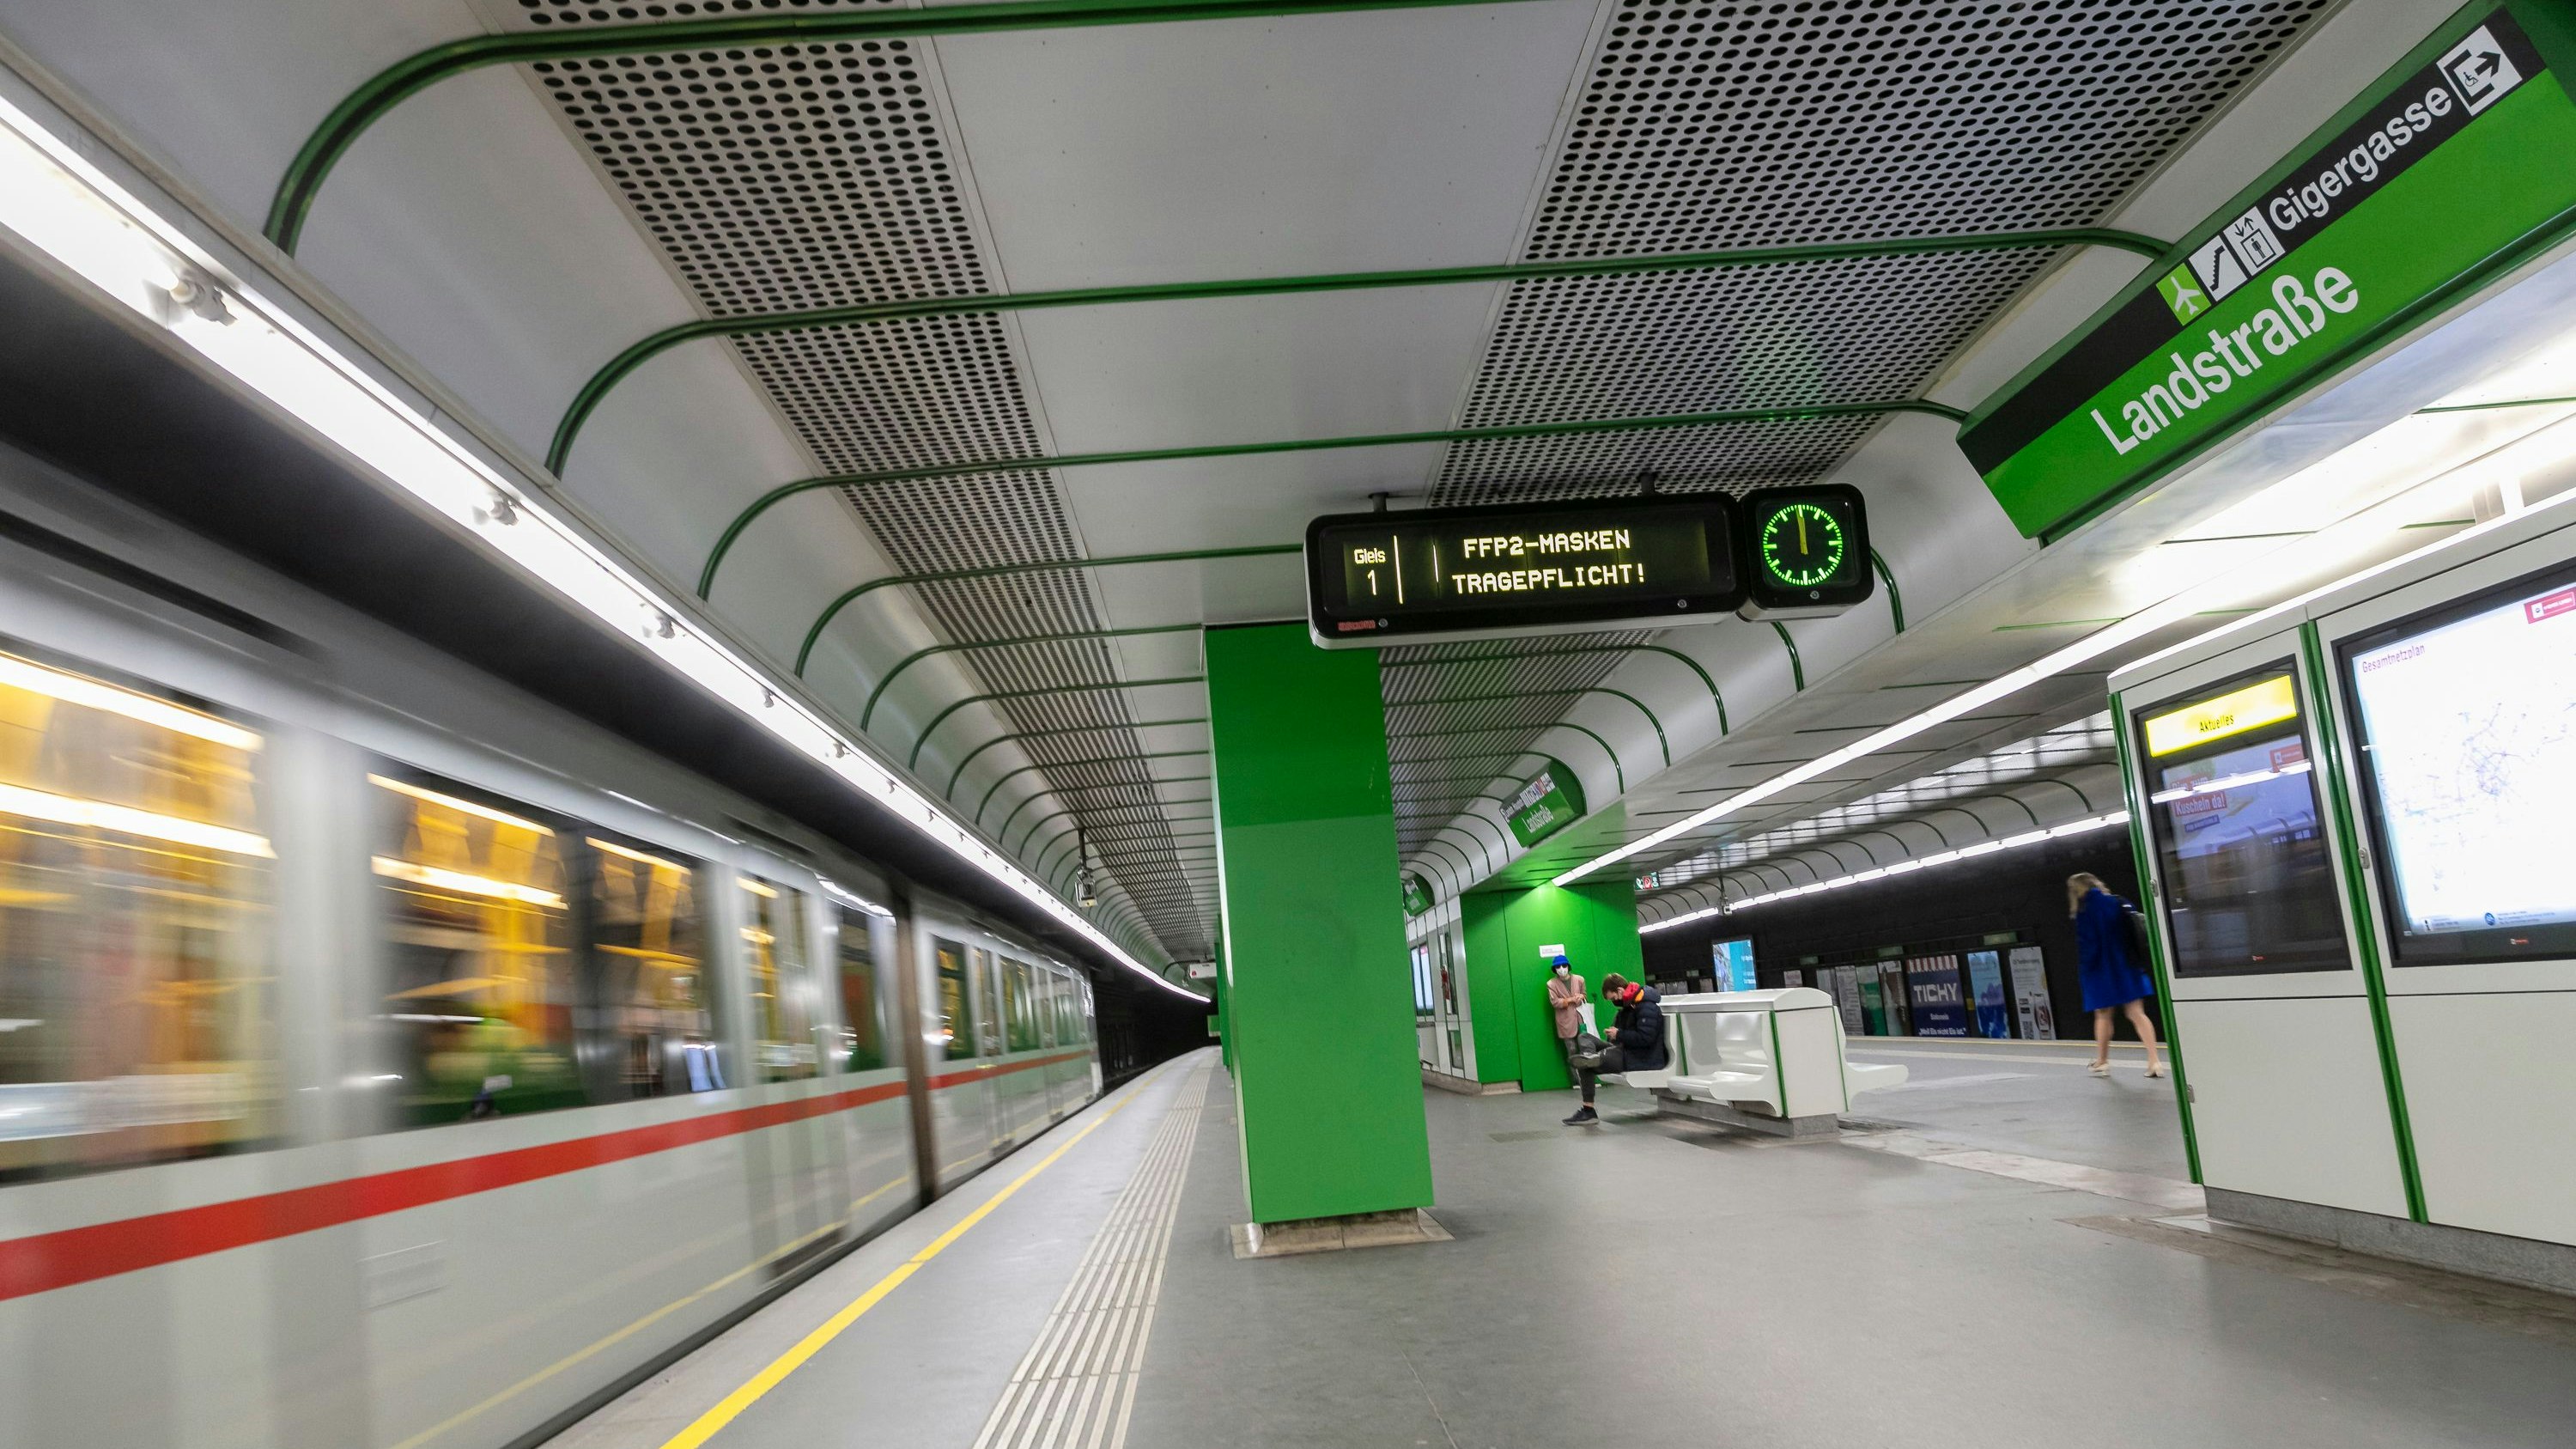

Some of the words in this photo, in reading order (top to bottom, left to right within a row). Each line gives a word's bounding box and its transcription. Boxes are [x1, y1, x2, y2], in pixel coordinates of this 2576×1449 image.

[2269, 86, 2452, 231] Gigergasse
[2090, 266, 2360, 456] Landstraße
[1353, 547, 1387, 564] Gleis
[1463, 528, 1631, 558] FFP2-MASKEN
[1367, 569, 1377, 596] 1
[1451, 563, 1644, 595] TRAGEPFLICHT!
[2362, 645, 2426, 673] Gesamtnetzplan
[2199, 715, 2234, 734] Aktuelles
[1913, 983, 1957, 1003] TICHY
